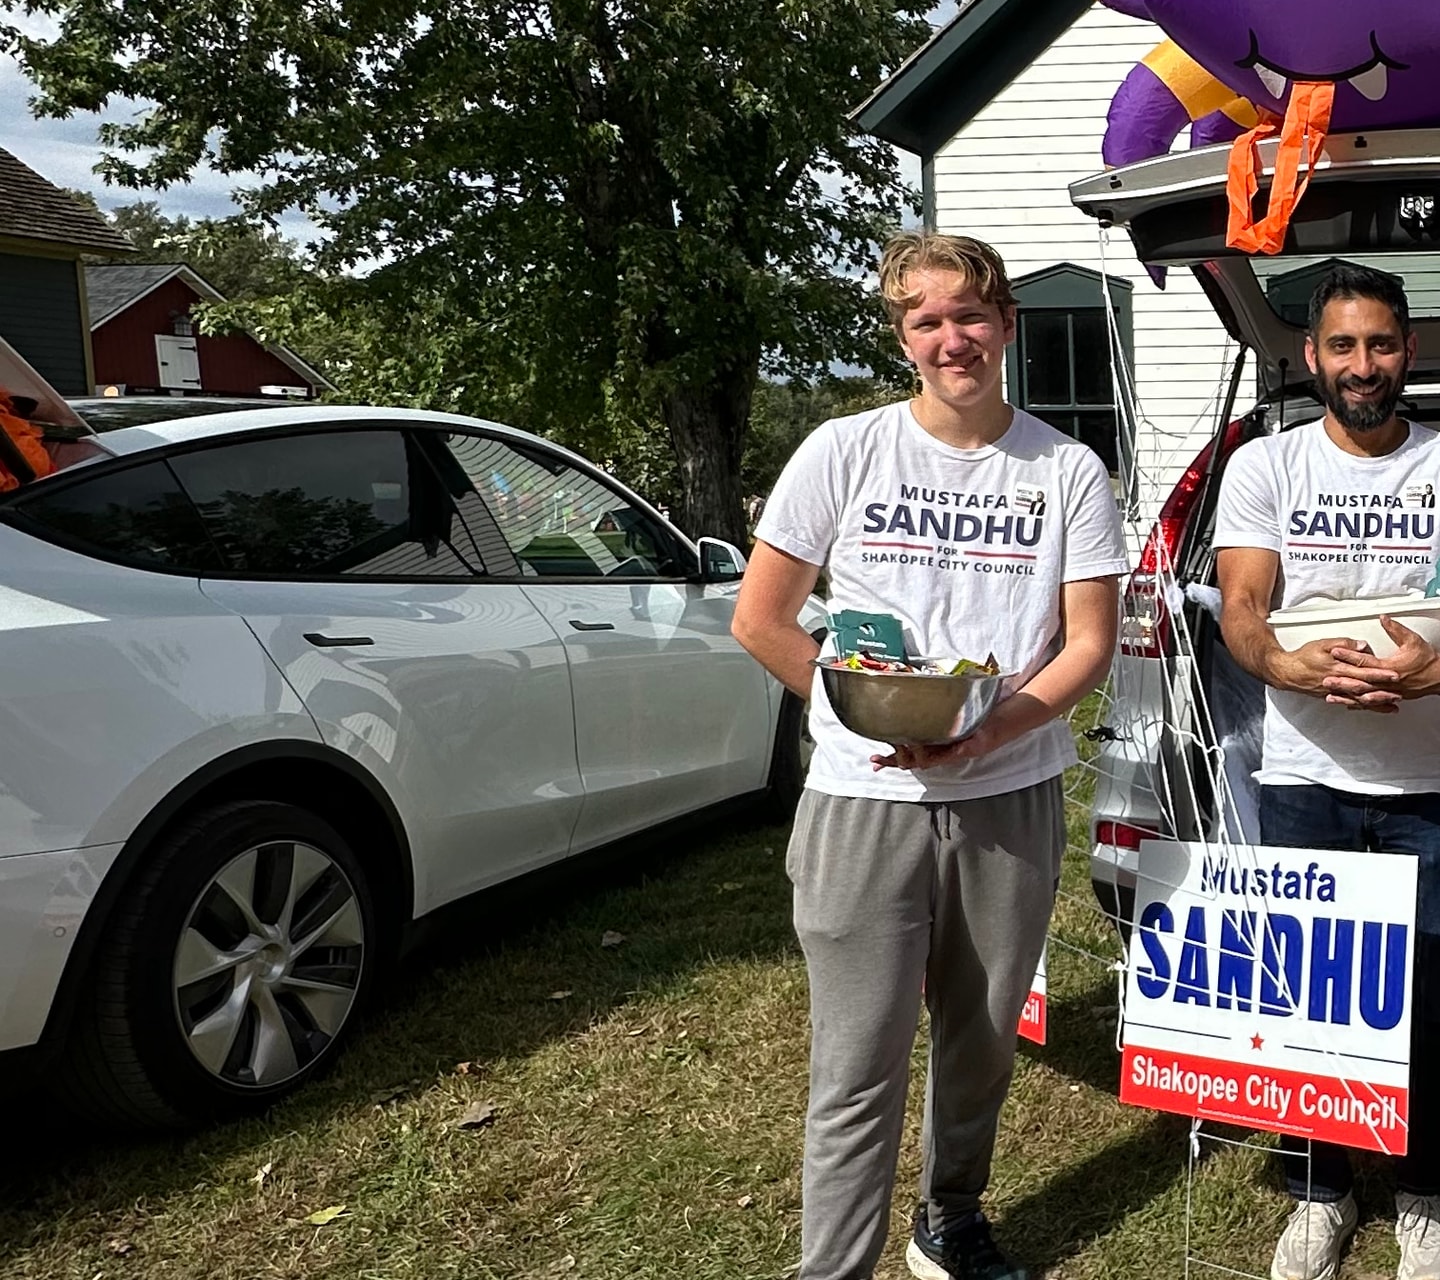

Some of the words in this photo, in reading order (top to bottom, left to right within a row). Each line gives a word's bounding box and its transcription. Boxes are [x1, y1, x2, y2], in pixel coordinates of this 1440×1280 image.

[901, 483, 1009, 509] MUSTAFA
[1318, 493, 1403, 509] MUSTAFA
[863, 502, 1044, 547] SANDHU
[1289, 509, 1435, 540] SANDHU
[937, 545, 959, 557] FOR
[1288, 552, 1349, 563] SHAKOPEE
[1352, 553, 1377, 563] CITY
[1378, 554, 1432, 564] COUNCIL
[1350, 543, 1368, 551] FOR
[862, 552, 934, 567] SHAKOPEE
[938, 559, 970, 571] CITY
[974, 562, 1036, 576] COUNCIL
[1201, 855, 1336, 903] Mustafa
[1136, 901, 1409, 1031] SANDHU
[1131, 1054, 1240, 1105] Shakopee
[1244, 1074, 1292, 1119] City
[1299, 1083, 1396, 1131] Council
